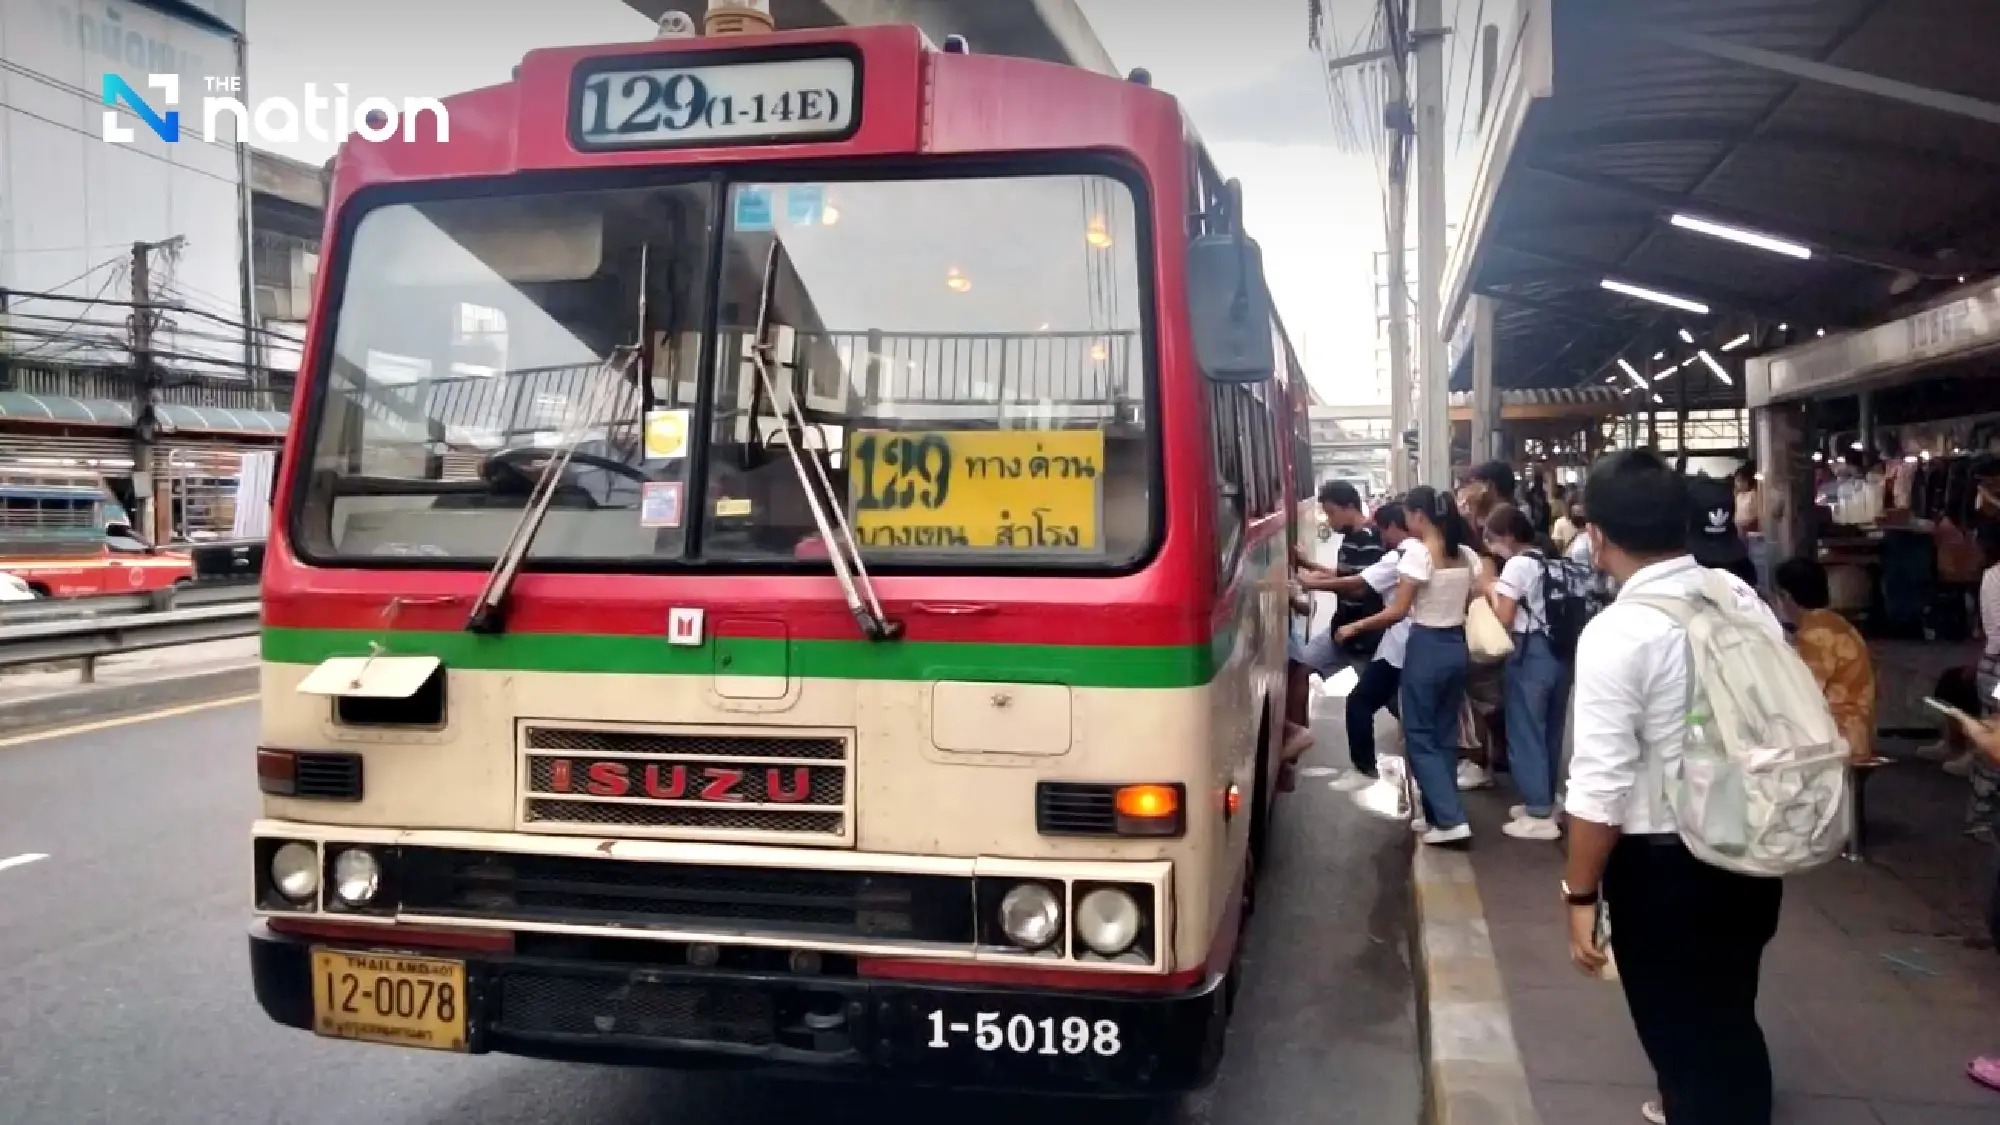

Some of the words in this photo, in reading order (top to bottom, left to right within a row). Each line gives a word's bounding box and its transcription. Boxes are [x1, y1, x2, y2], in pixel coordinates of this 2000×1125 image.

[855, 435, 953, 510] 129
[995, 507, 1079, 548] สำโรง
[550, 758, 812, 804] ISUZU
[346, 955, 429, 974] THAILAND
[327, 972, 456, 1023] 12-0078
[926, 1010, 1122, 1057] 1-50198
